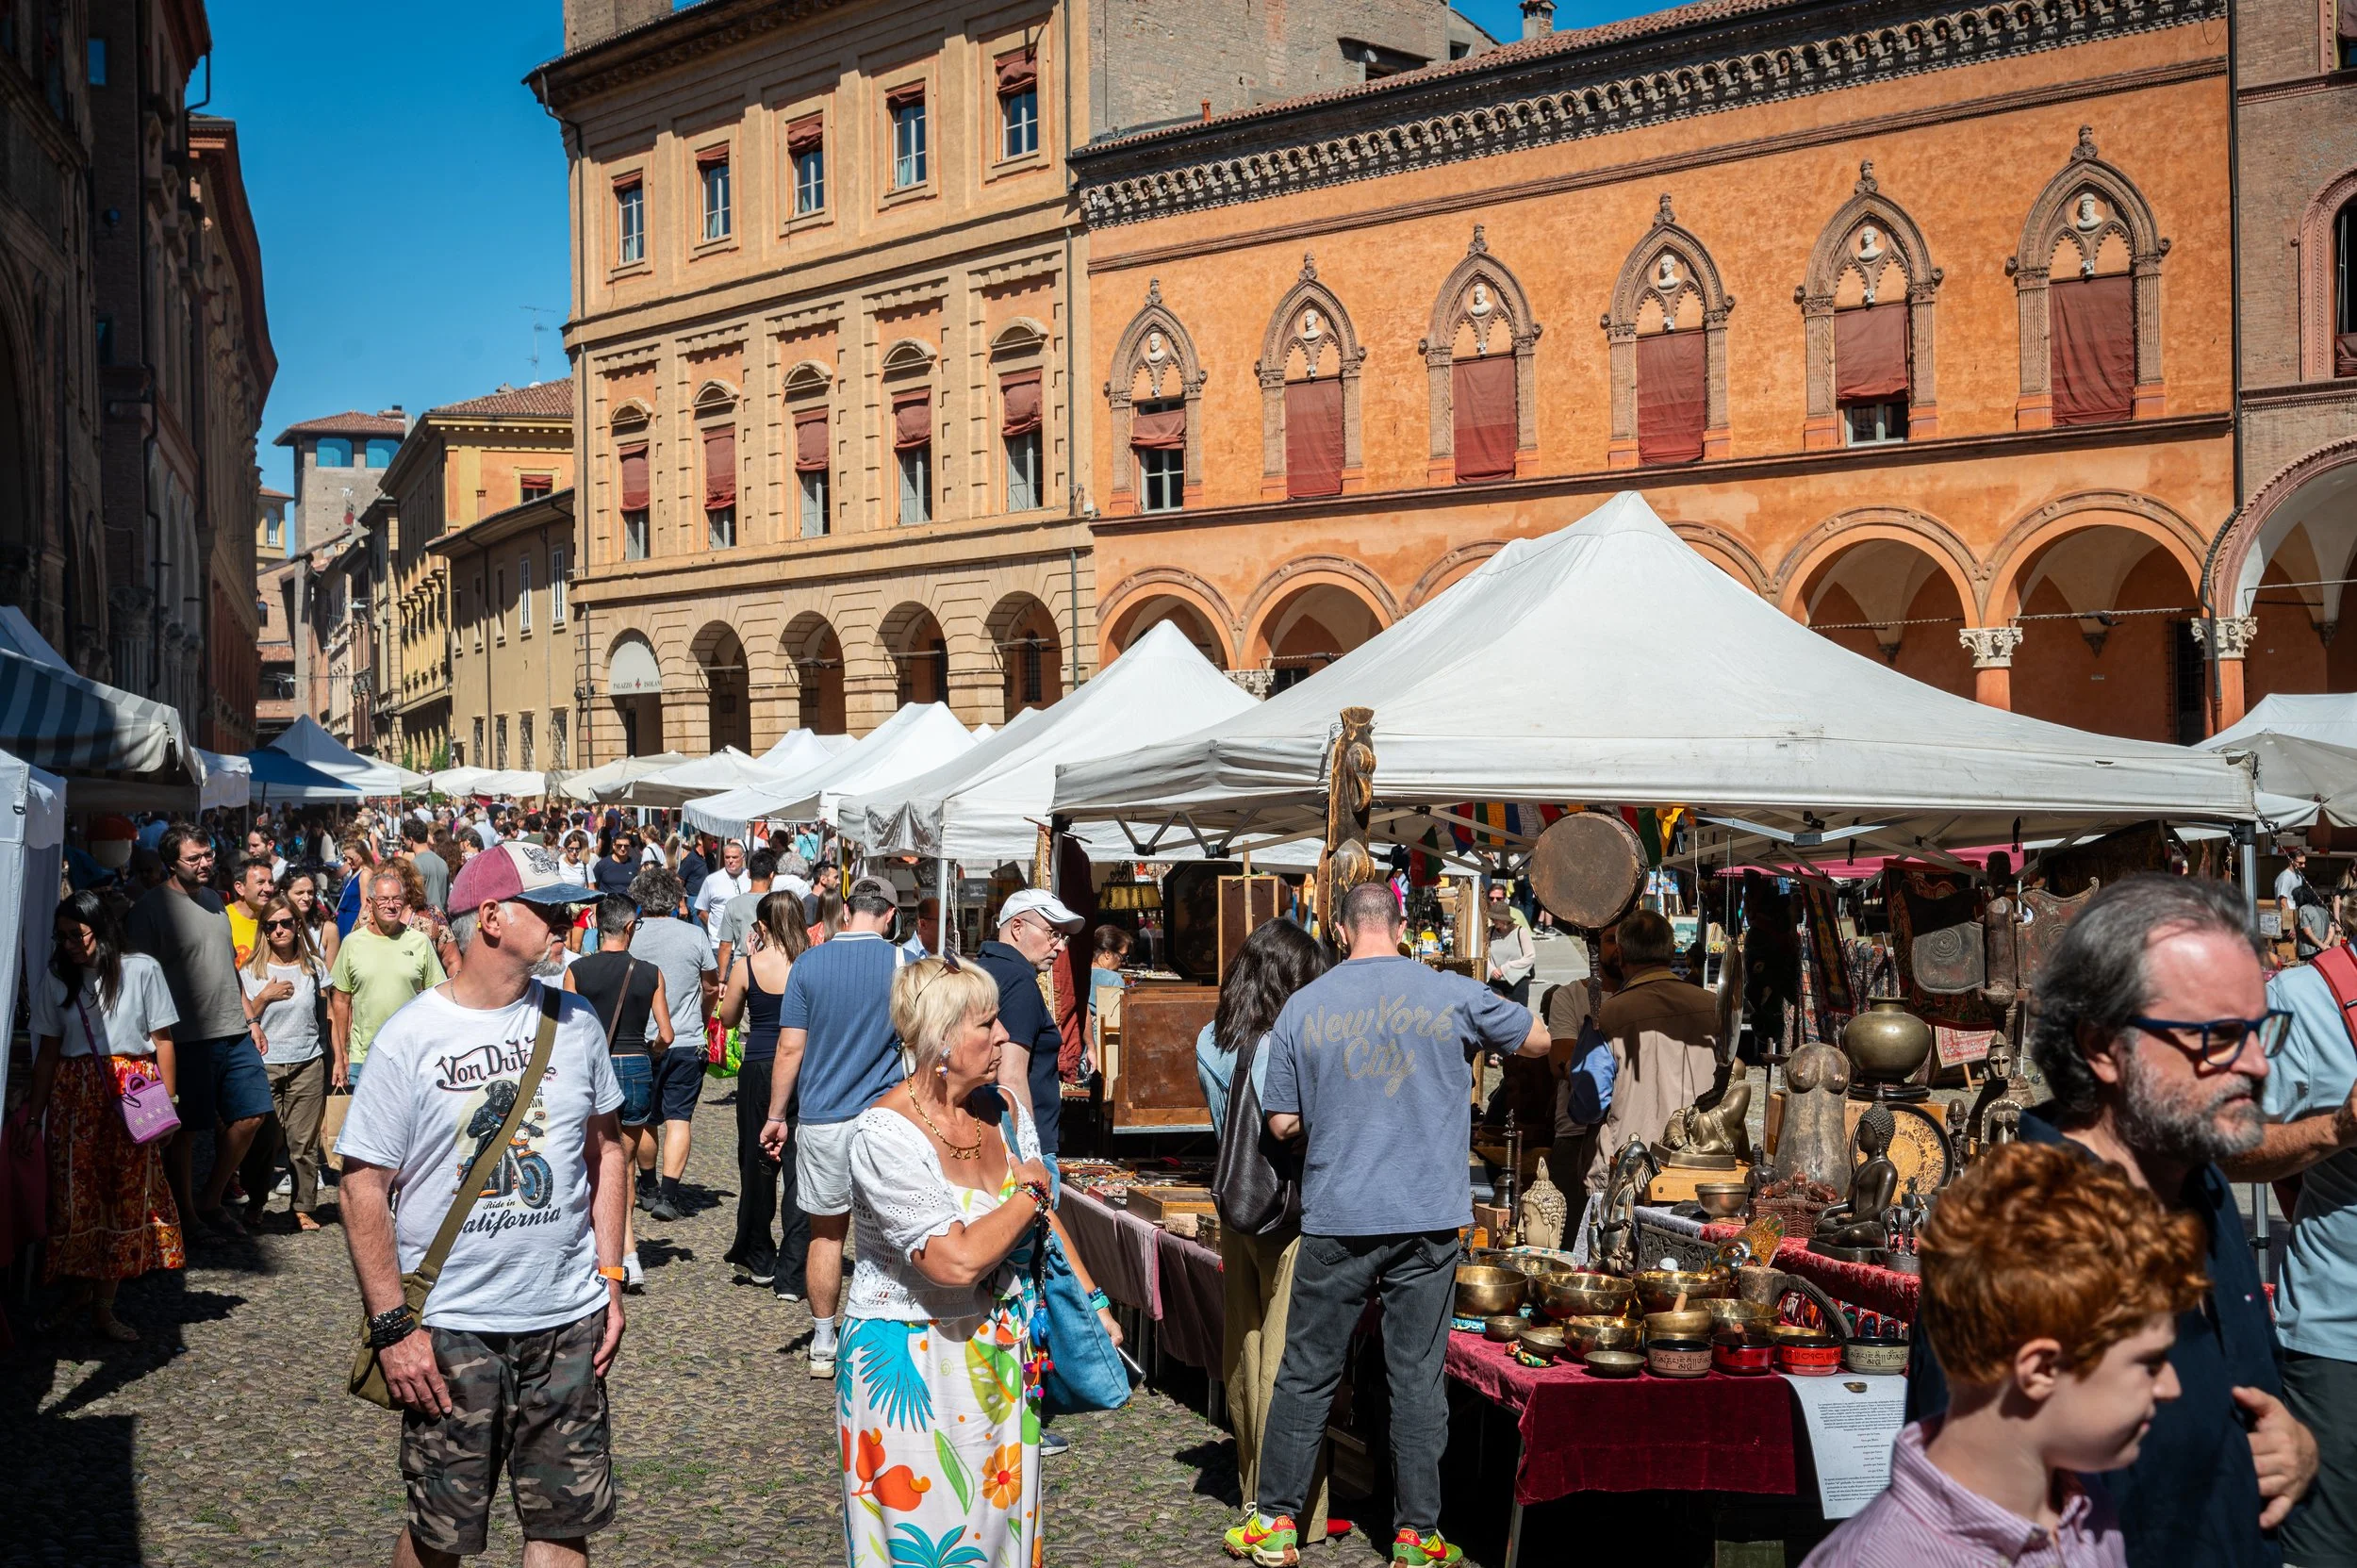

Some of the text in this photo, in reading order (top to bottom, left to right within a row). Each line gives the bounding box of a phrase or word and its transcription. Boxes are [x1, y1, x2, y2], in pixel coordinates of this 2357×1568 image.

[1304, 995, 1456, 1057] New York
[435, 1049, 486, 1091] Von
[1343, 1037, 1417, 1098] City
[462, 1204, 562, 1239] alifornia
[483, 1201, 504, 1210] Ride
[1277, 1518, 1294, 1527] NIKE
[1398, 1531, 1416, 1542] NIKE
